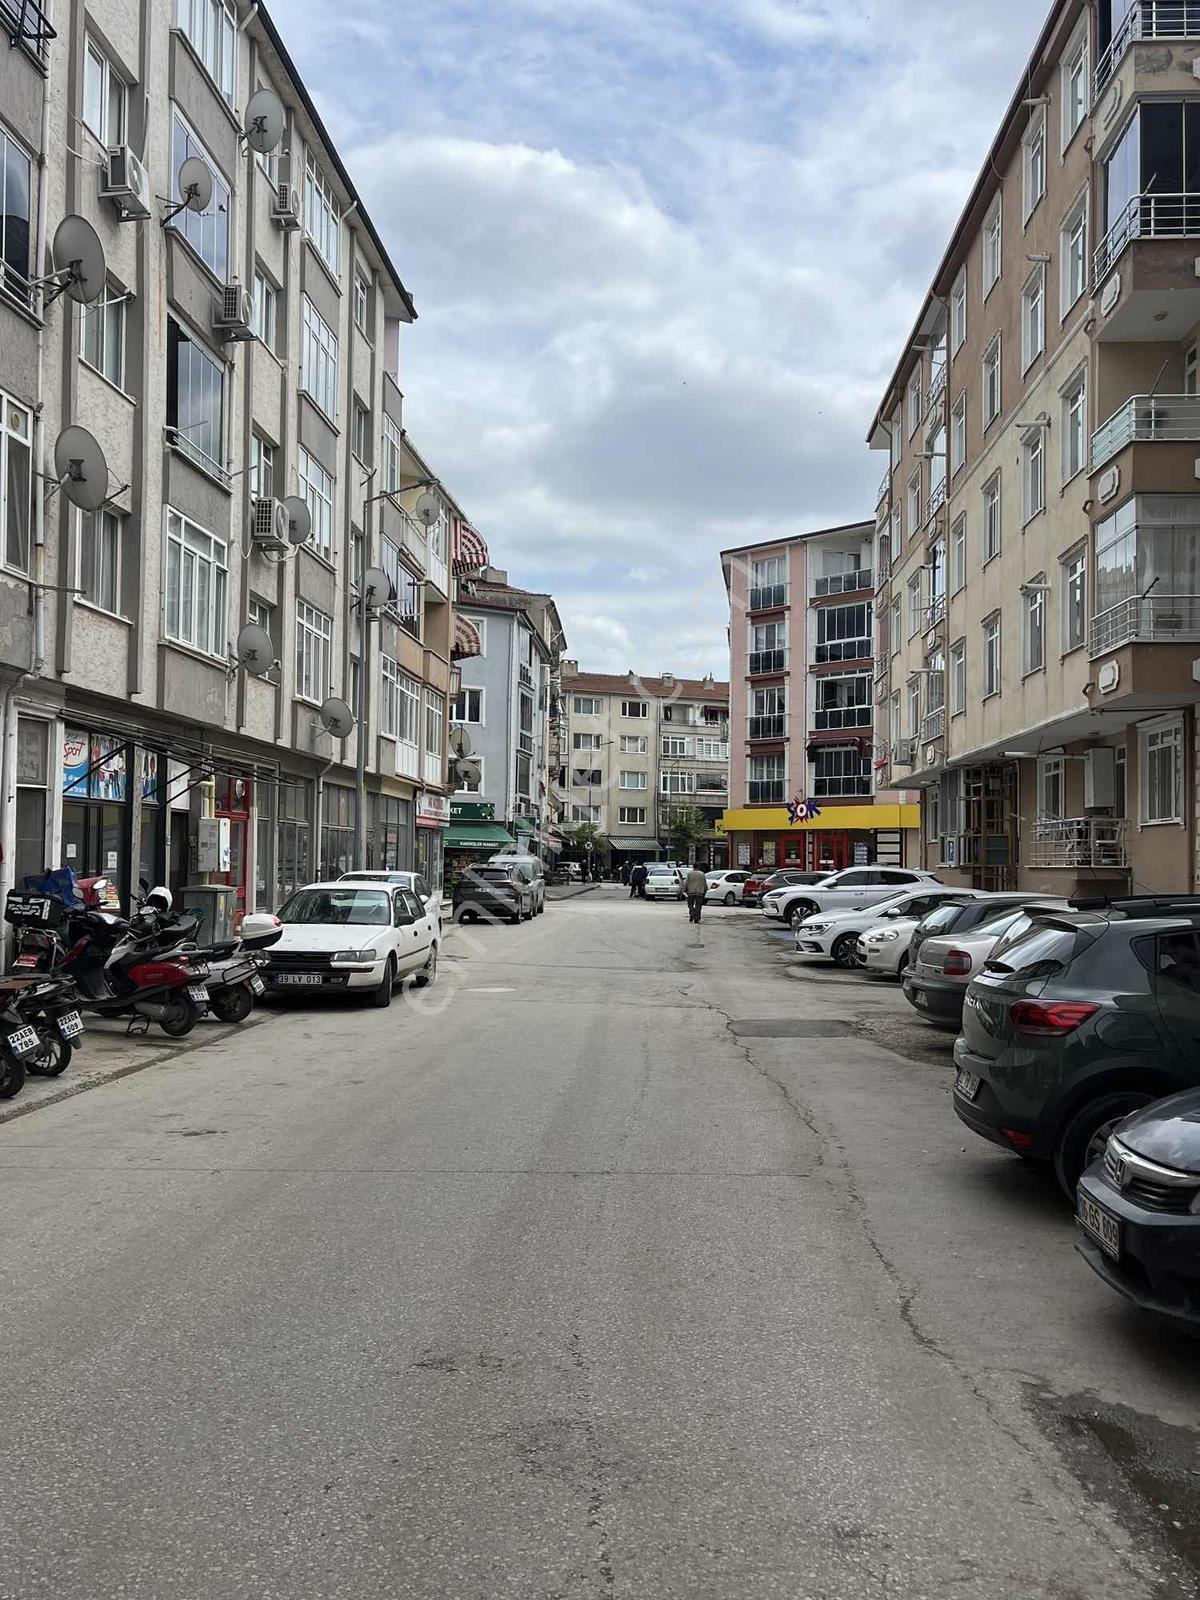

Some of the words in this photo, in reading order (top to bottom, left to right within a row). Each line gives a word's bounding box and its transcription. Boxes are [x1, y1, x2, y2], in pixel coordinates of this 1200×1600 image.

[279, 975, 289, 984] 39
[292, 975, 303, 984] LV
[306, 975, 321, 985] 013
